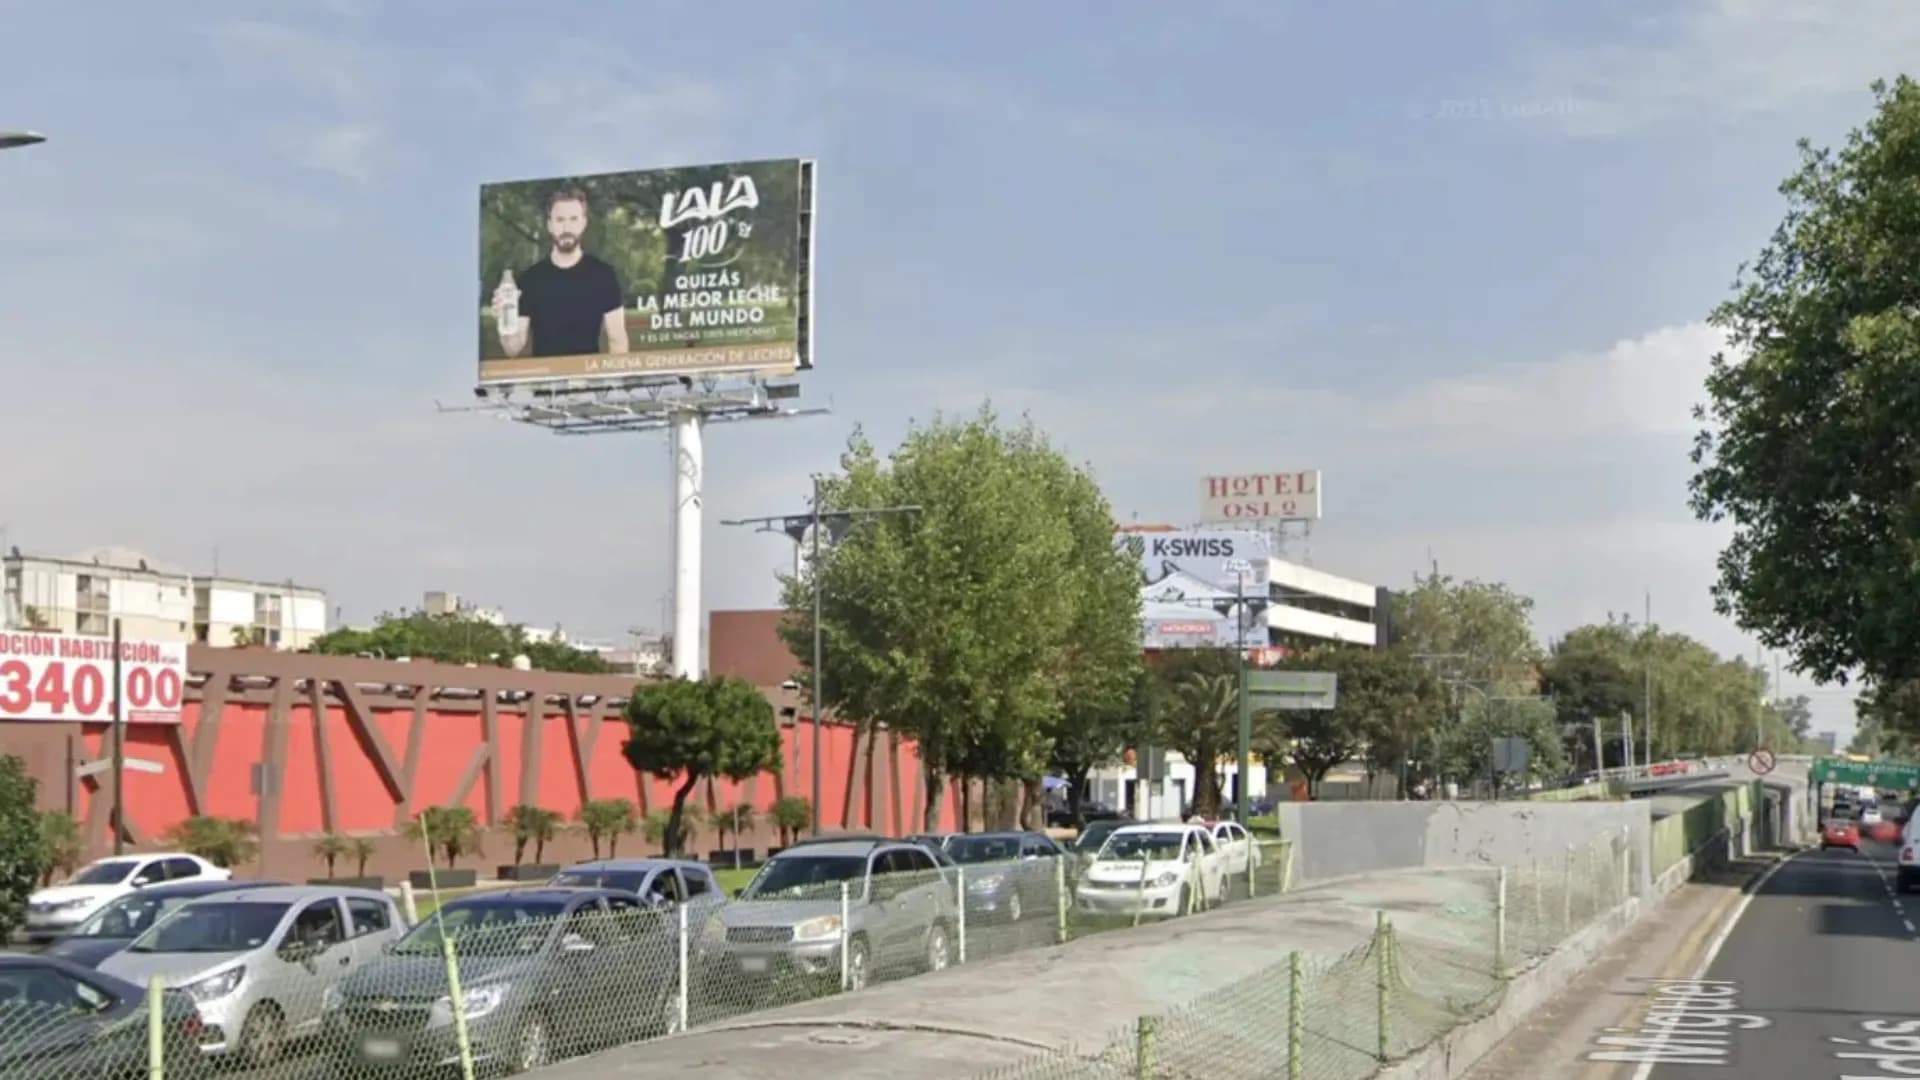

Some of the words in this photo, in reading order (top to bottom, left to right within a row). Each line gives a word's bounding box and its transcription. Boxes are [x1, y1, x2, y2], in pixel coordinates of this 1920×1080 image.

[660, 175, 759, 228] LALA
[675, 269, 740, 289] QUIZÁS
[637, 294, 658, 311] LA
[664, 291, 722, 309] MEJOR
[728, 284, 780, 305] LECHE
[651, 314, 682, 330] DEL
[690, 307, 764, 327] MUNDO
[585, 359, 599, 371] LA
[601, 356, 641, 370] NUEVA
[645, 350, 724, 368] GENERACIÓN
[728, 350, 744, 362] DE
[747, 347, 791, 361] LECHES
[1209, 472, 1315, 498] HOTEL
[1223, 500, 1297, 519] OSLO
[60, 638, 160, 664] HABITCIÓN
